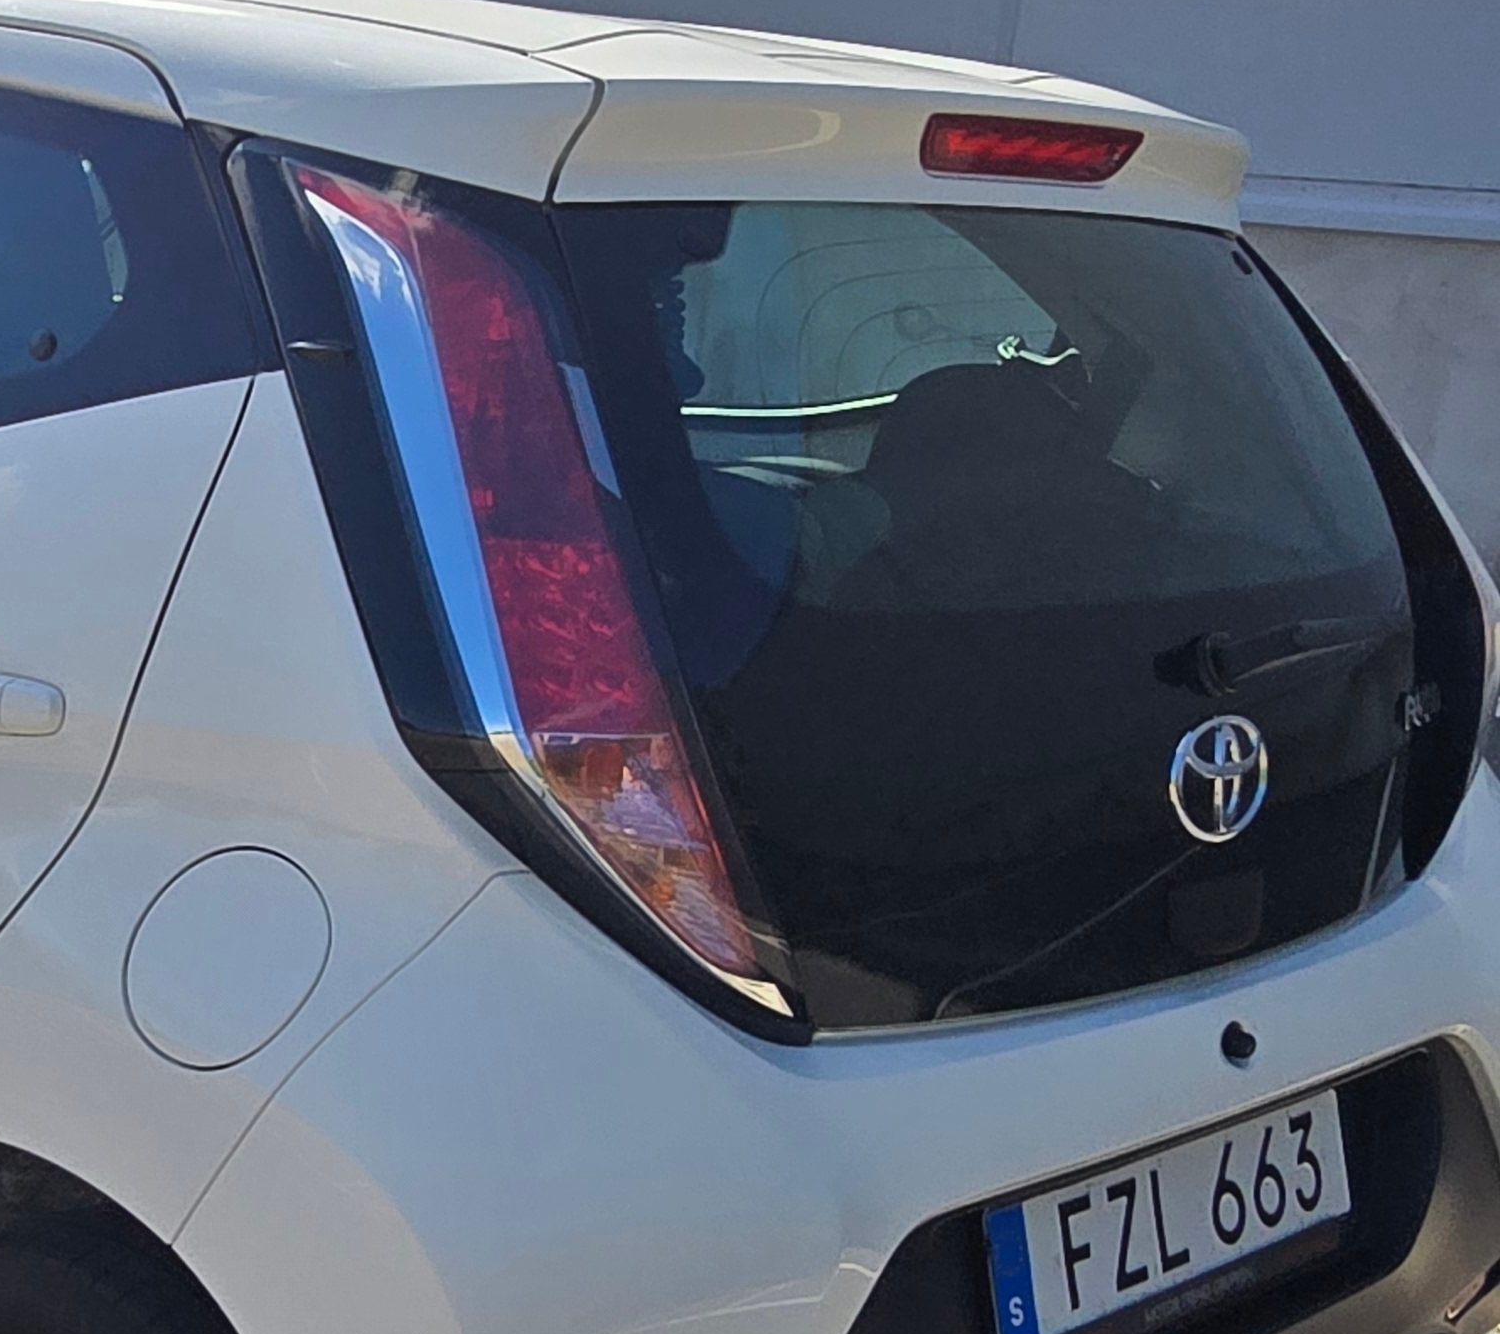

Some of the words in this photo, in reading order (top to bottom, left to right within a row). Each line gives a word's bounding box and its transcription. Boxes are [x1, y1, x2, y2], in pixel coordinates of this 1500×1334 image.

[1058, 1170, 1190, 1311] FZL
[1212, 1111, 1322, 1245] 663
[1008, 1297, 1025, 1327] S
